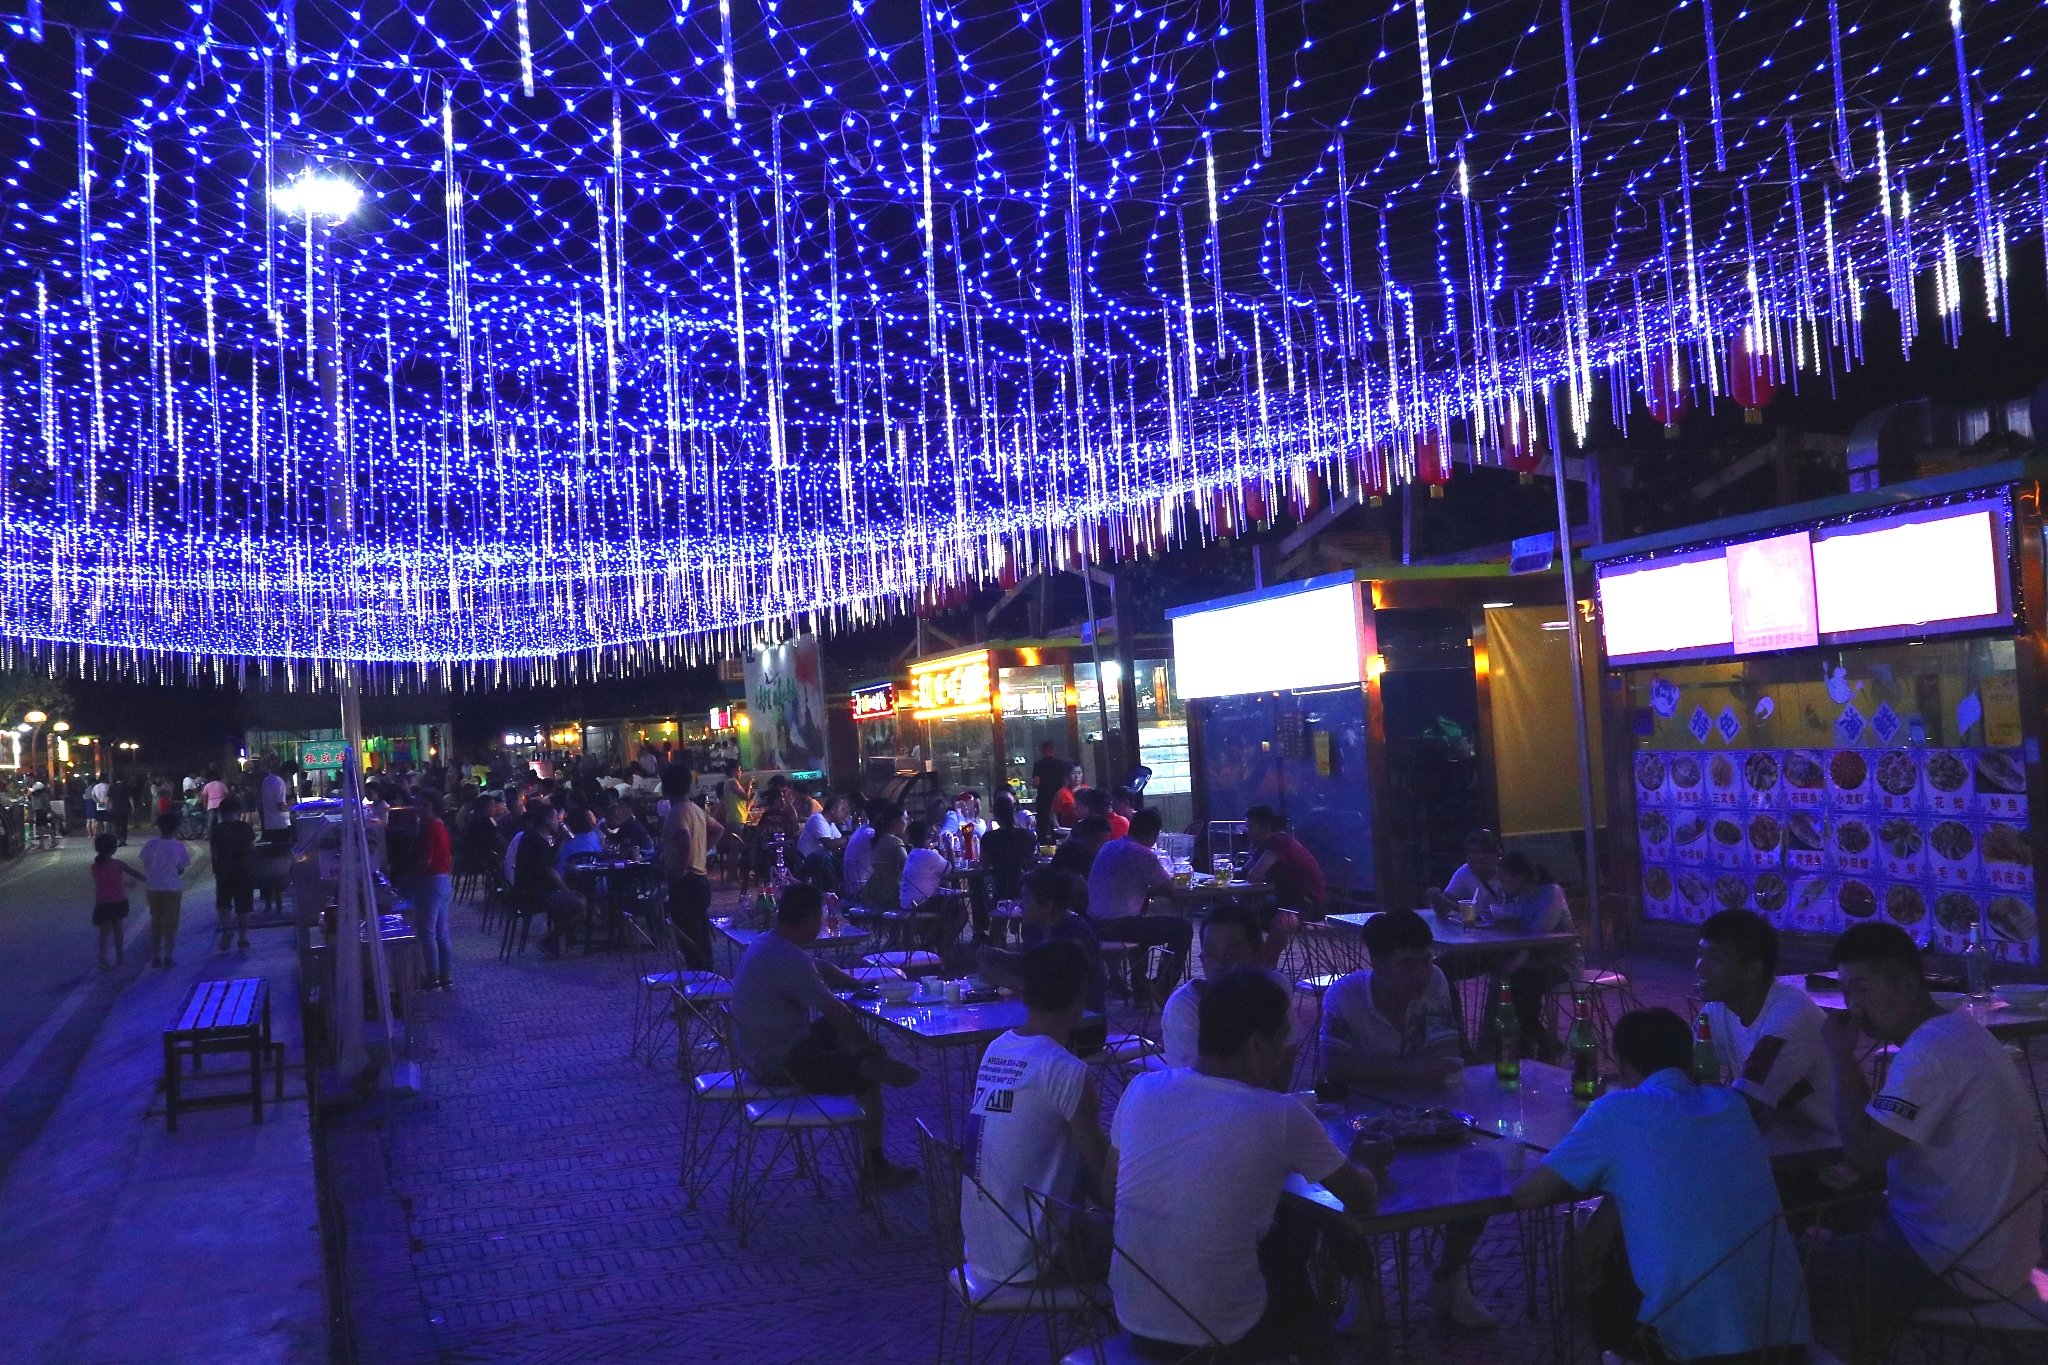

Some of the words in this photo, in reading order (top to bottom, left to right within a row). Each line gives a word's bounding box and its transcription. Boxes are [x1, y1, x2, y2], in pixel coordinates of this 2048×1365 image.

[1692, 710, 1739, 739] 特色
[1839, 706, 1897, 741] 海鲜
[1712, 792, 1736, 804] 三文鱼
[1791, 792, 1817, 804] 石斑鱼
[1836, 793, 1864, 806] 小龙虾
[1884, 796, 1911, 809] 扇贝
[1991, 870, 2028, 885] 扒皮鱼
[1875, 1099, 1910, 1117] YOUTH
